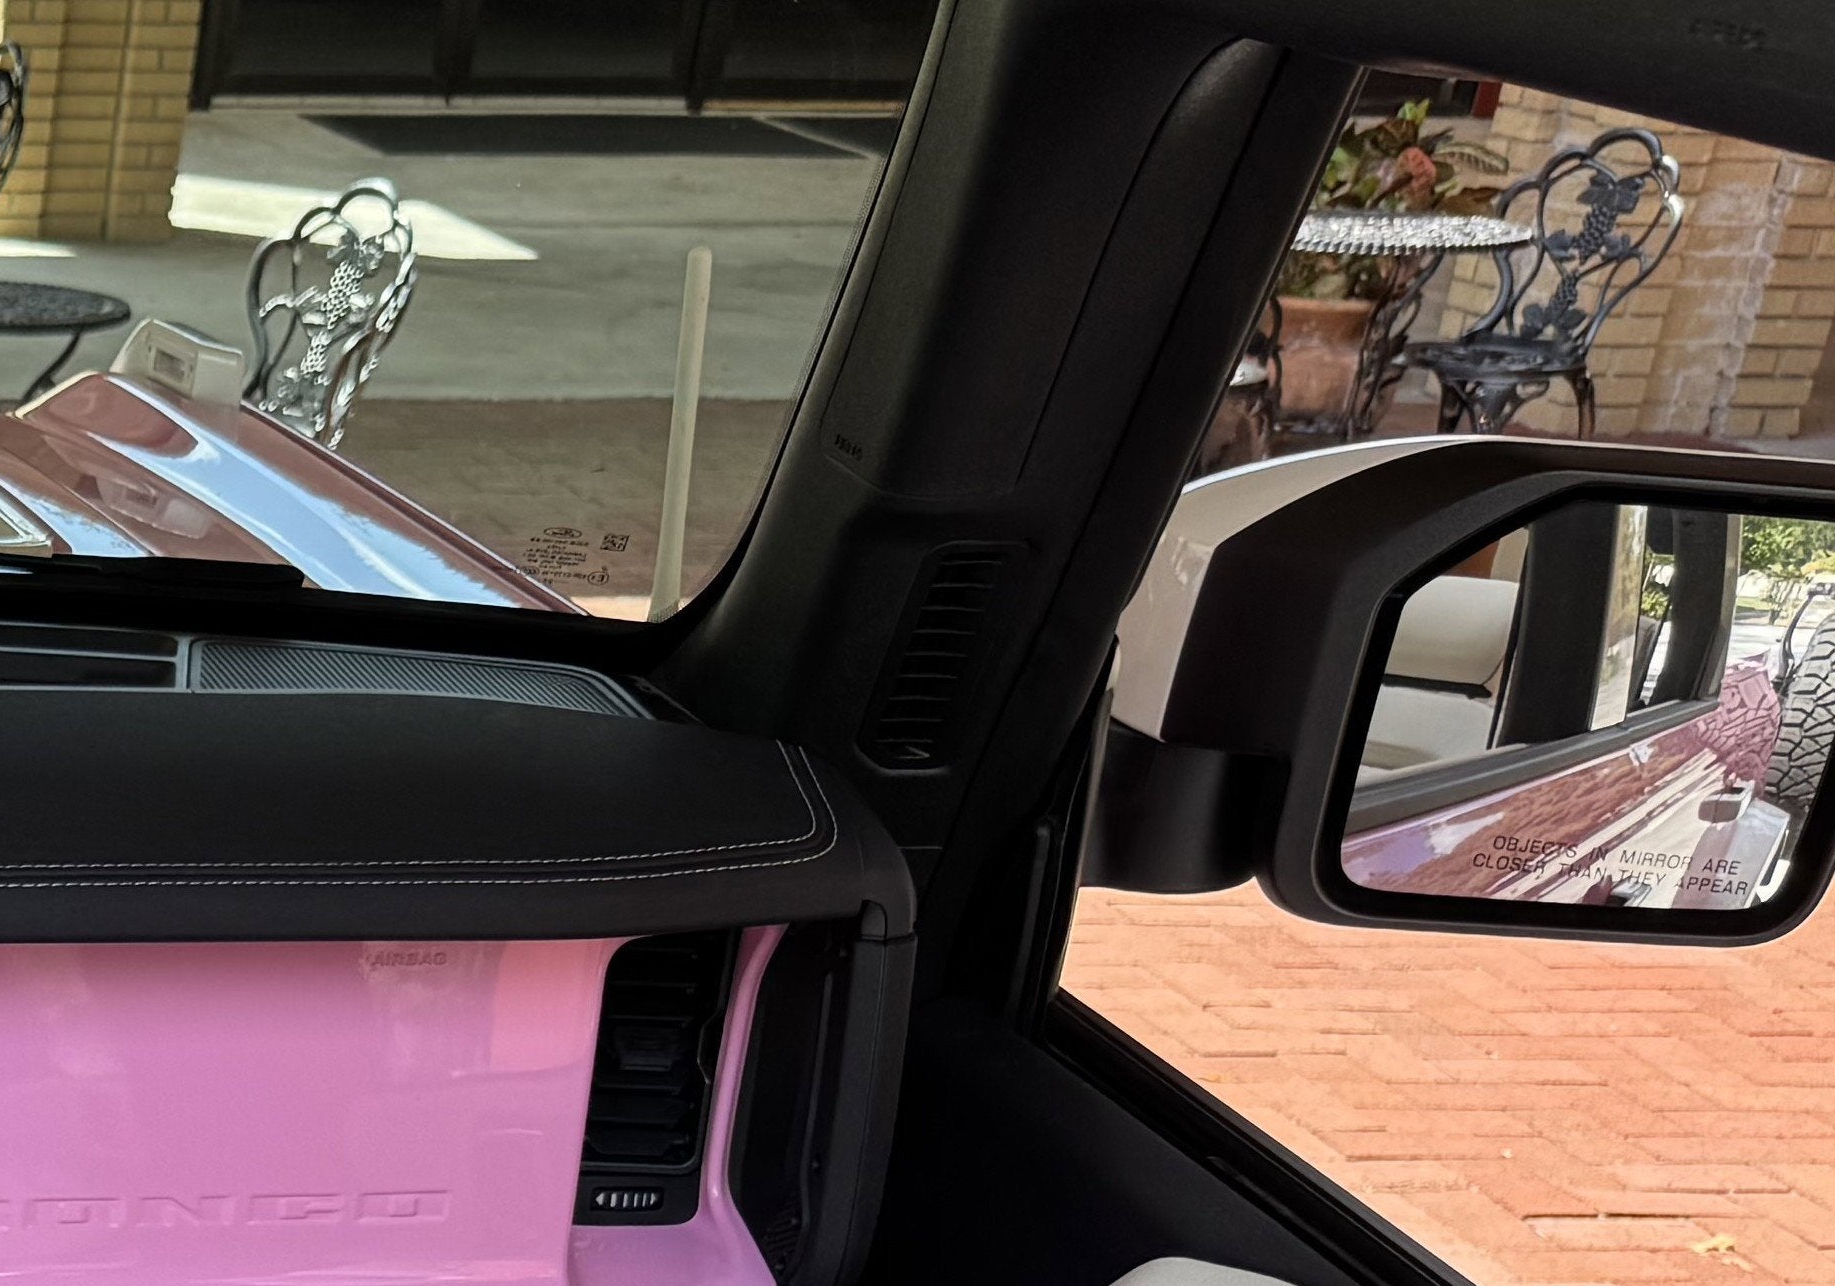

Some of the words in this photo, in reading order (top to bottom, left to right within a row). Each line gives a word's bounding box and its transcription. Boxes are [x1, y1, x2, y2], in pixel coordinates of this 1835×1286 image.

[1472, 853, 1547, 874] CLOSER
[1558, 862, 1606, 882] THAN
[1617, 868, 1666, 887] THEY
[1675, 874, 1748, 895] APPEAR
[1493, 835, 1578, 858] OBJECTS
[1588, 846, 1607, 861] IN
[1620, 849, 1693, 871] MIRROR
[1701, 859, 1741, 876] ARE
